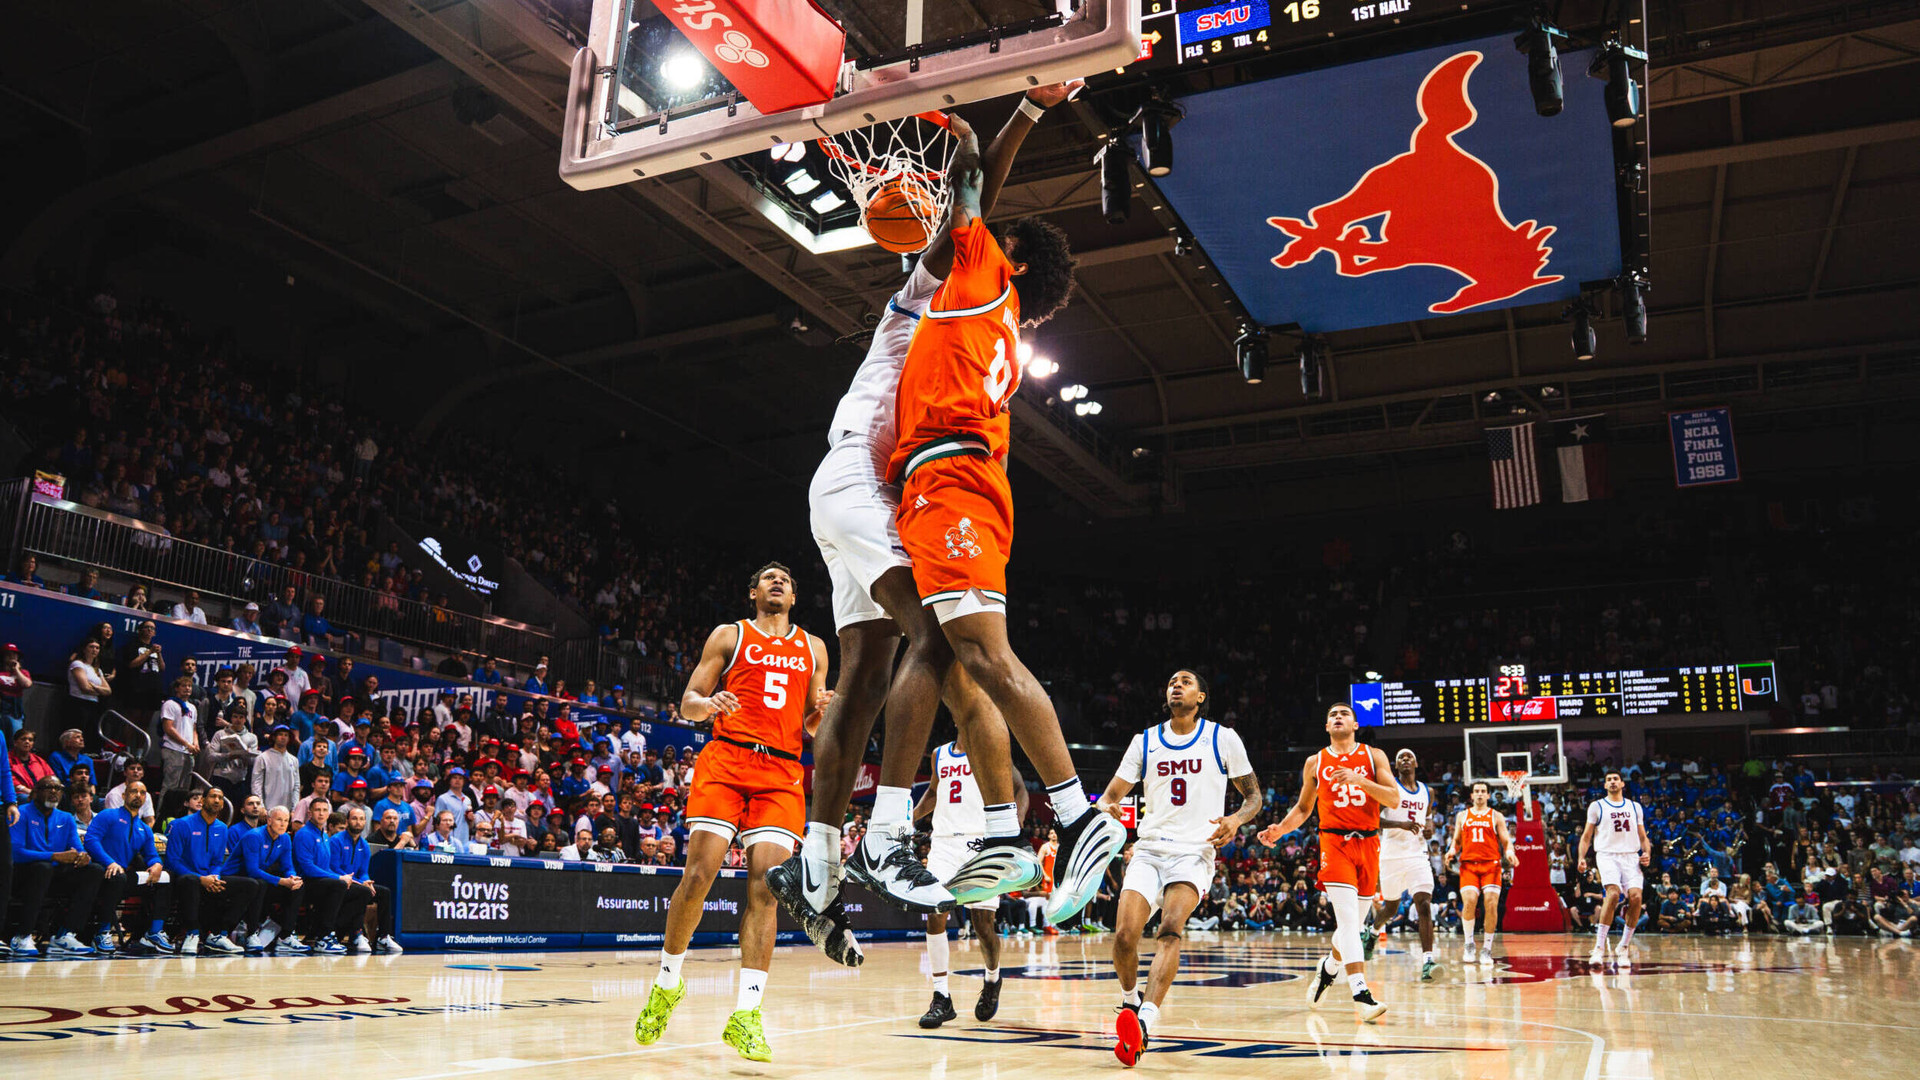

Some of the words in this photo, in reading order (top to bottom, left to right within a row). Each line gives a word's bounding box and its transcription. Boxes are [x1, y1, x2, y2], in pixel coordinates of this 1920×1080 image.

[1152, 3, 1161, 13] 0
[1351, 4, 1376, 21] 1ST
[1379, 0, 1411, 16] HALF
[1197, 5, 1250, 32] SMU
[1283, 0, 1320, 23] 16
[1185, 44, 1203, 58] FLS
[1211, 40, 1222, 53] 3
[1233, 34, 1252, 48] TOL
[1256, 30, 1267, 42] 4
[1683, 425, 1719, 438] NCAA
[1683, 438, 1724, 451] FINAL
[1687, 451, 1723, 464] FOUR
[1689, 464, 1726, 480] 1956
[237, 646, 253, 658] THE
[745, 644, 807, 671] Canes
[1500, 665, 1525, 676] 9:33
[763, 671, 788, 709] 5
[1384, 682, 1403, 690] PLAYER
[1498, 677, 1524, 697] 27
[641, 723, 652, 733] 112
[941, 764, 972, 779] SMU
[1157, 759, 1202, 776] SMU
[1322, 765, 1368, 782] Ces
[949, 780, 961, 803] 2
[1171, 777, 1187, 806] 9
[1331, 783, 1367, 808] 35
[1401, 800, 1424, 811] SMU
[1408, 811, 1417, 823] 5
[1466, 818, 1490, 827] Canes
[1614, 820, 1630, 832] 24
[1472, 828, 1484, 842] 11
[430, 854, 454, 864] UTSW
[490, 857, 512, 868] UTSW
[544, 860, 564, 870] UTSW
[594, 863, 613, 872] UTSW
[640, 866, 657, 875] UTSW
[452, 874, 509, 900] forvis
[433, 901, 509, 920] mazars
[597, 896, 649, 910] Assurance
[663, 898, 671, 910] Ta
[703, 899, 738, 914] nsulting
[504, 936, 528, 944] Medical
[528, 936, 548, 944] Center
